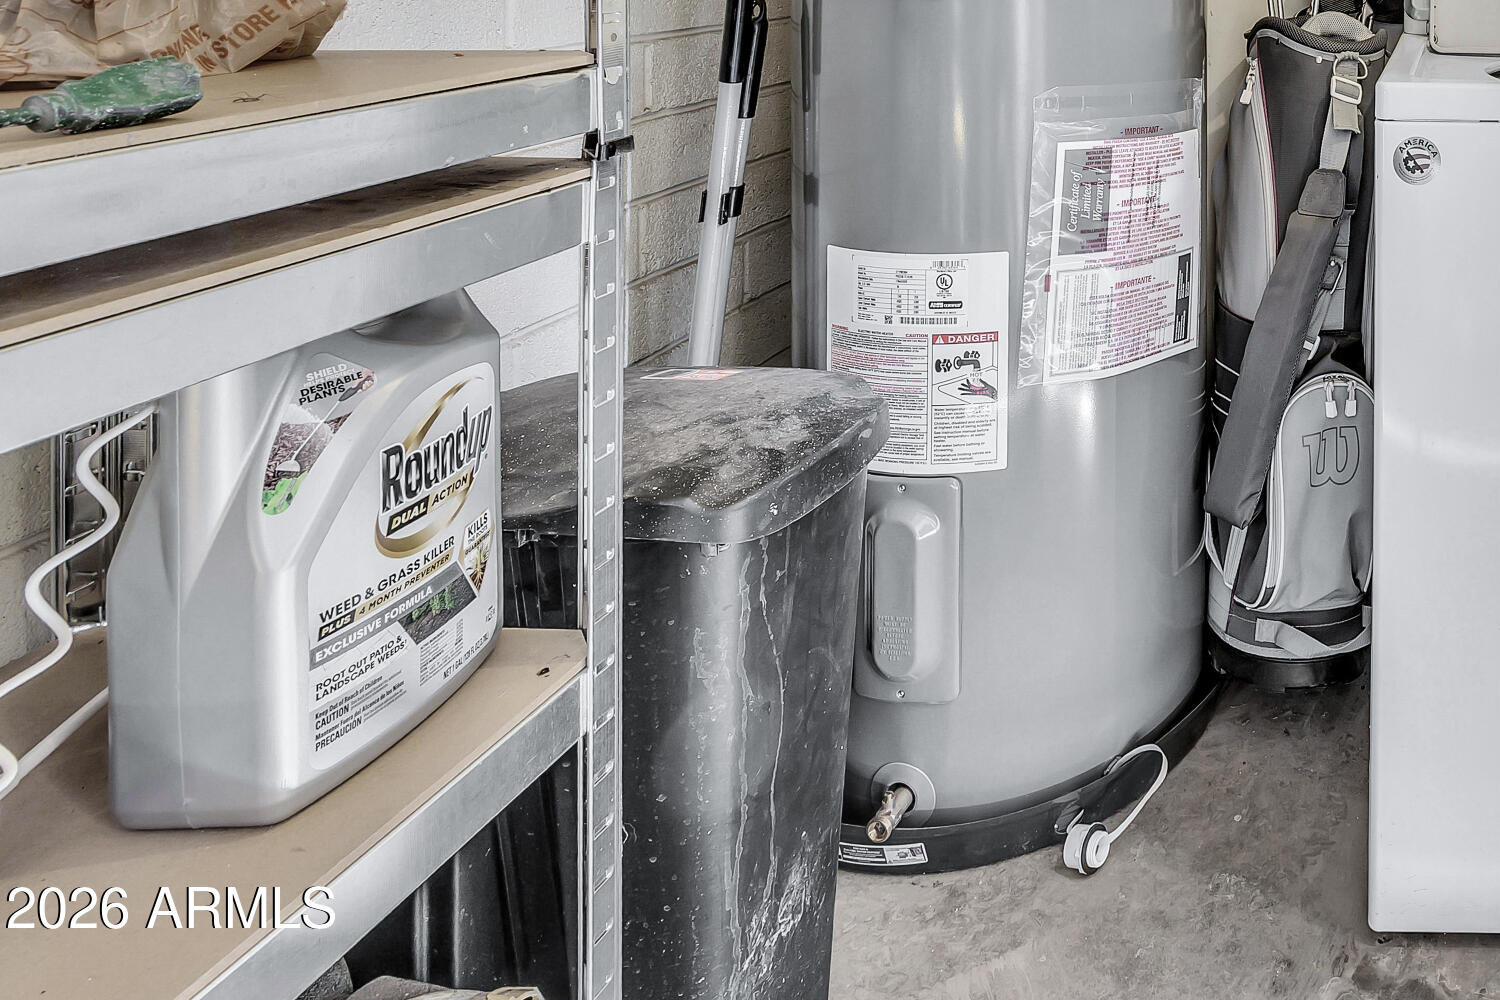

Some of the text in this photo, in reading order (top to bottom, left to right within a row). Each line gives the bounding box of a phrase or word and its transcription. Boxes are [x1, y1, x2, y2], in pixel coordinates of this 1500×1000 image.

[212, 4, 280, 58] STORE
[1124, 126, 1160, 136] IMPORTANT
[1399, 139, 1438, 158] AMERICA
[1067, 170, 1083, 232] Certificate of
[1080, 183, 1093, 219] Limited
[1092, 178, 1107, 221] Warranty
[1115, 275, 1152, 290] IMPORTANTE
[948, 334, 995, 343] DANGER
[300, 371, 363, 397] DESIRABLE
[305, 363, 347, 382] SHIELD
[299, 385, 346, 406] PLANTS
[381, 404, 493, 514] Roundup
[431, 473, 469, 506] ACTION
[390, 502, 427, 530] DUAL
[468, 512, 487, 538] KILLS
[318, 536, 455, 623] WEED & GRASS KILLER
[321, 554, 450, 637] PLUS 4 MONTH PREVENTER
[314, 620, 382, 663] EXCLUSIVE
[384, 586, 434, 623] FORMULA
[315, 668, 347, 692] ROOT
[347, 656, 367, 674] OUT
[369, 640, 395, 661] PATIO
[315, 661, 375, 702] LANDSCAPE
[315, 703, 350, 730] CAUTION
